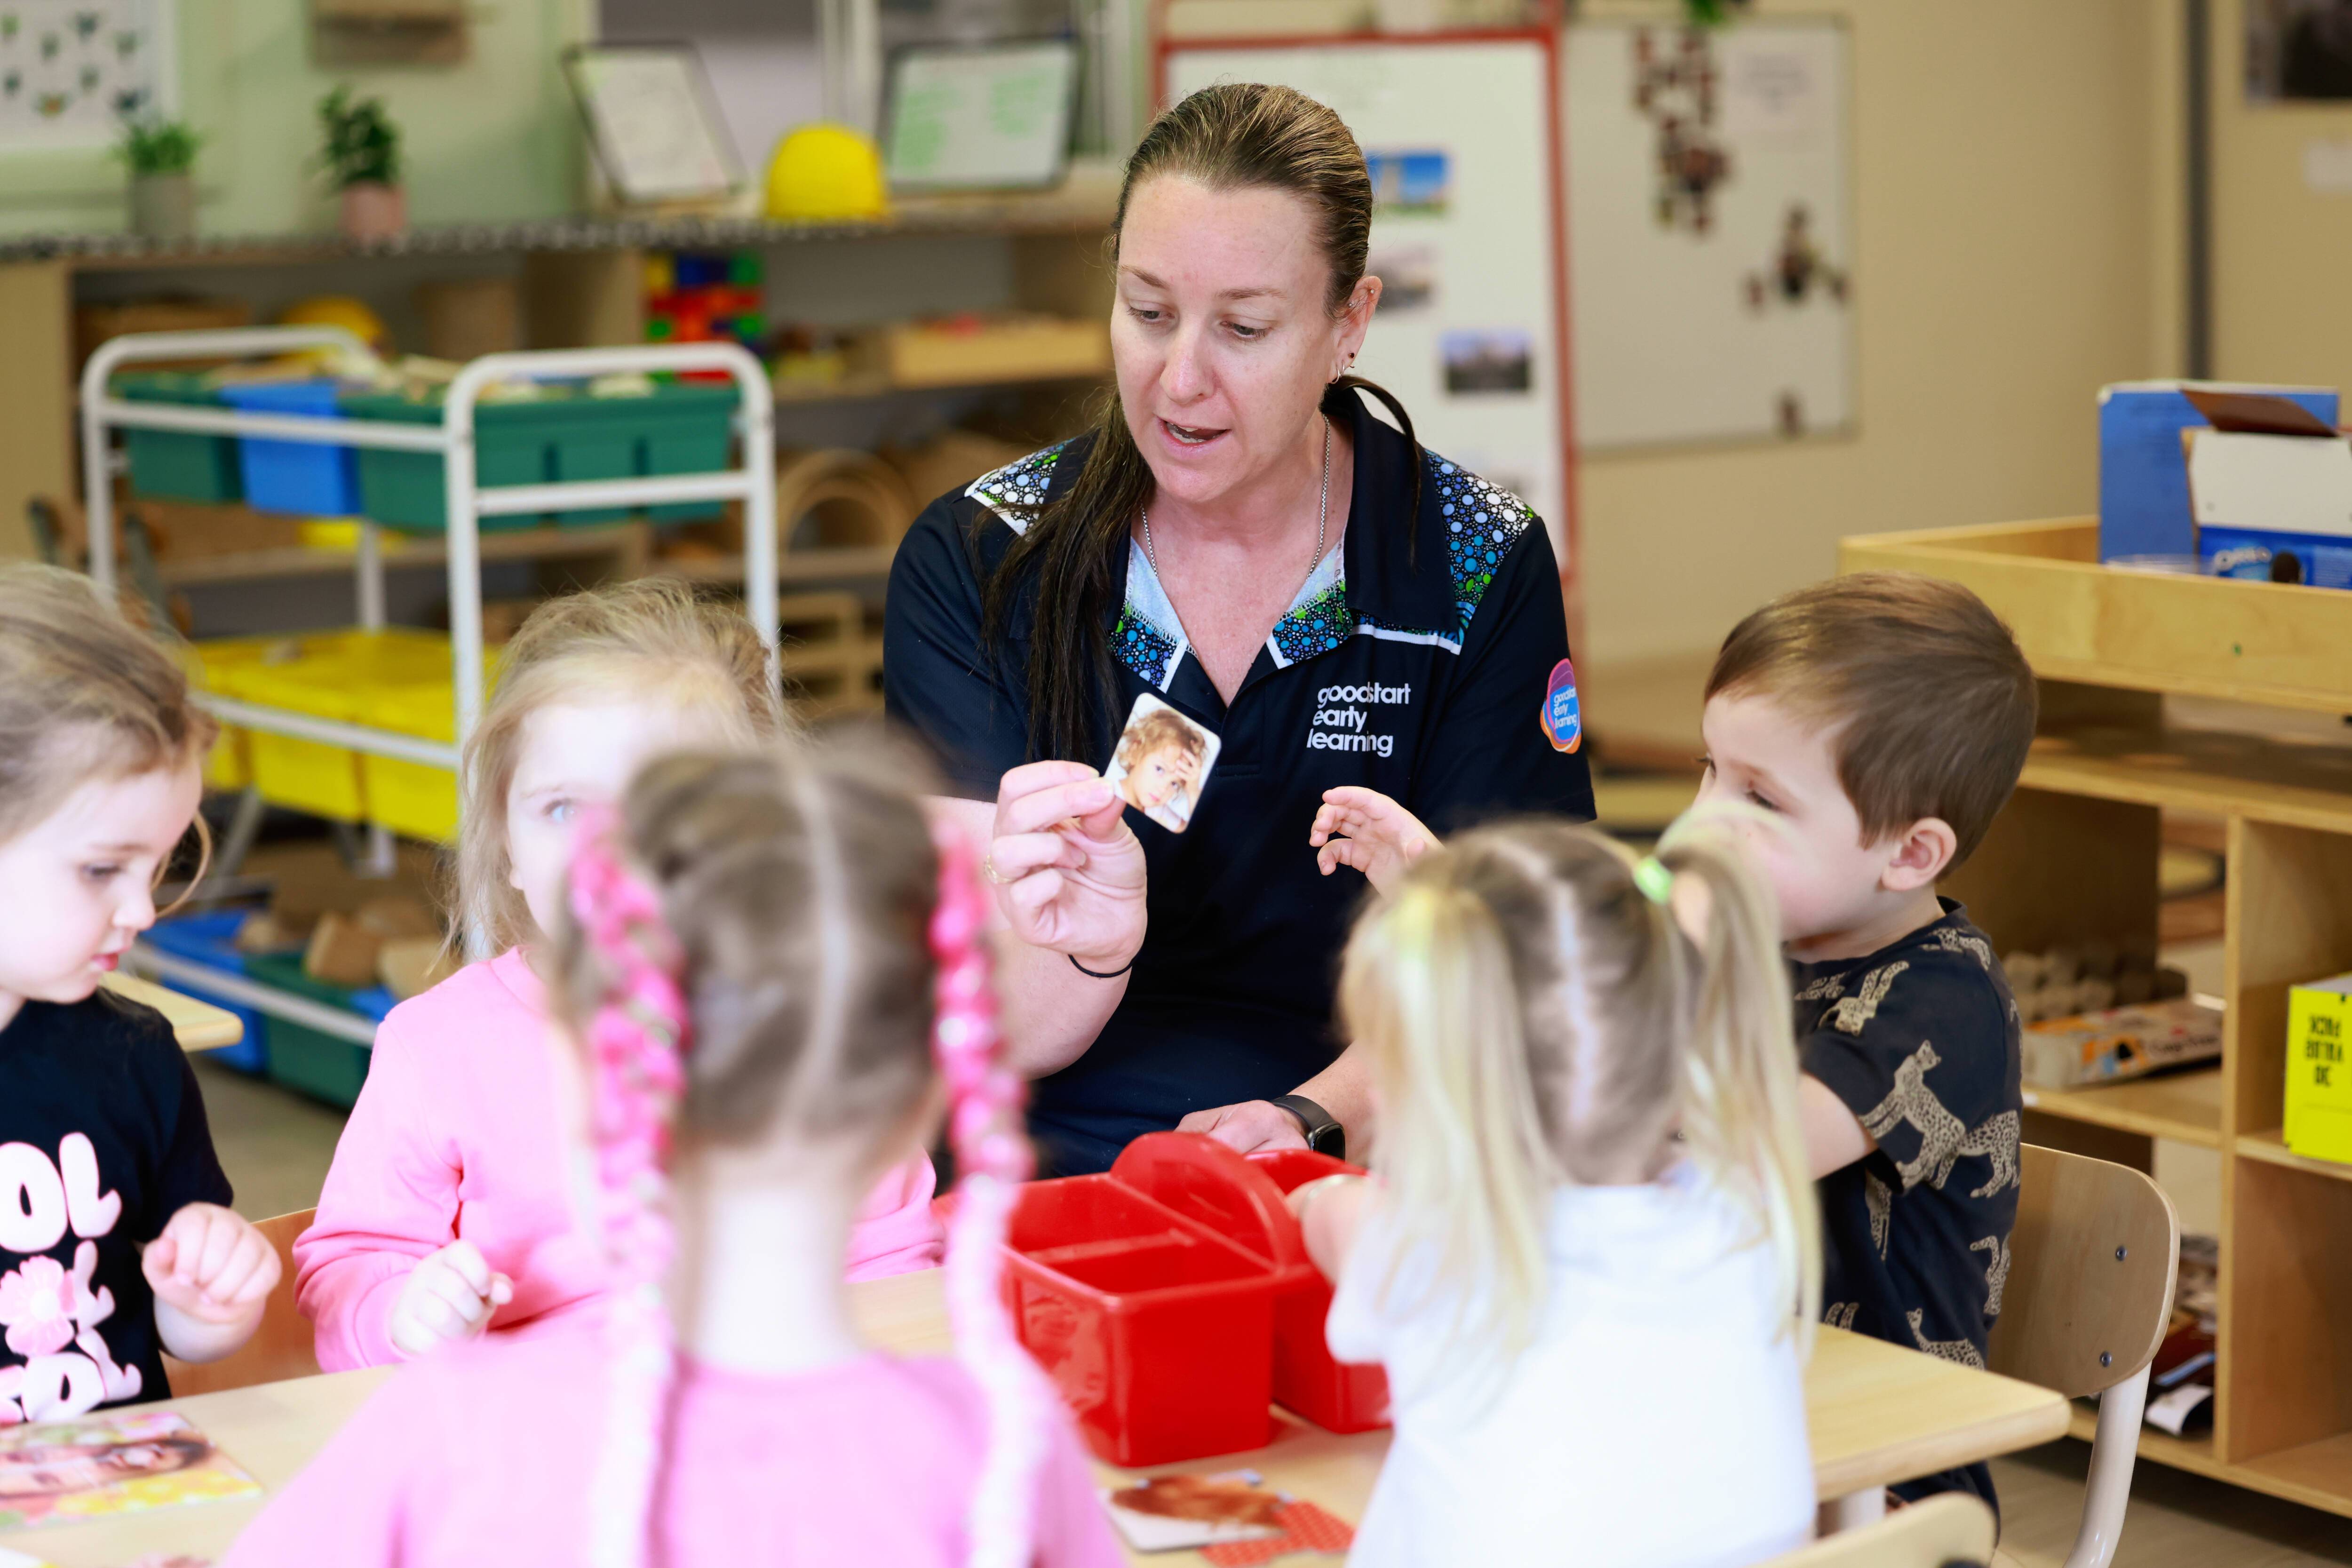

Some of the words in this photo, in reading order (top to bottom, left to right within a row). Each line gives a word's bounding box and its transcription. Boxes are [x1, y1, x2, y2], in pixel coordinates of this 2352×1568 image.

[1318, 682, 1411, 708] goodstart
[1313, 706, 1367, 732] early
[1554, 703, 1568, 716] early
[1554, 714, 1577, 728] learning
[1306, 728, 1393, 757] learning
